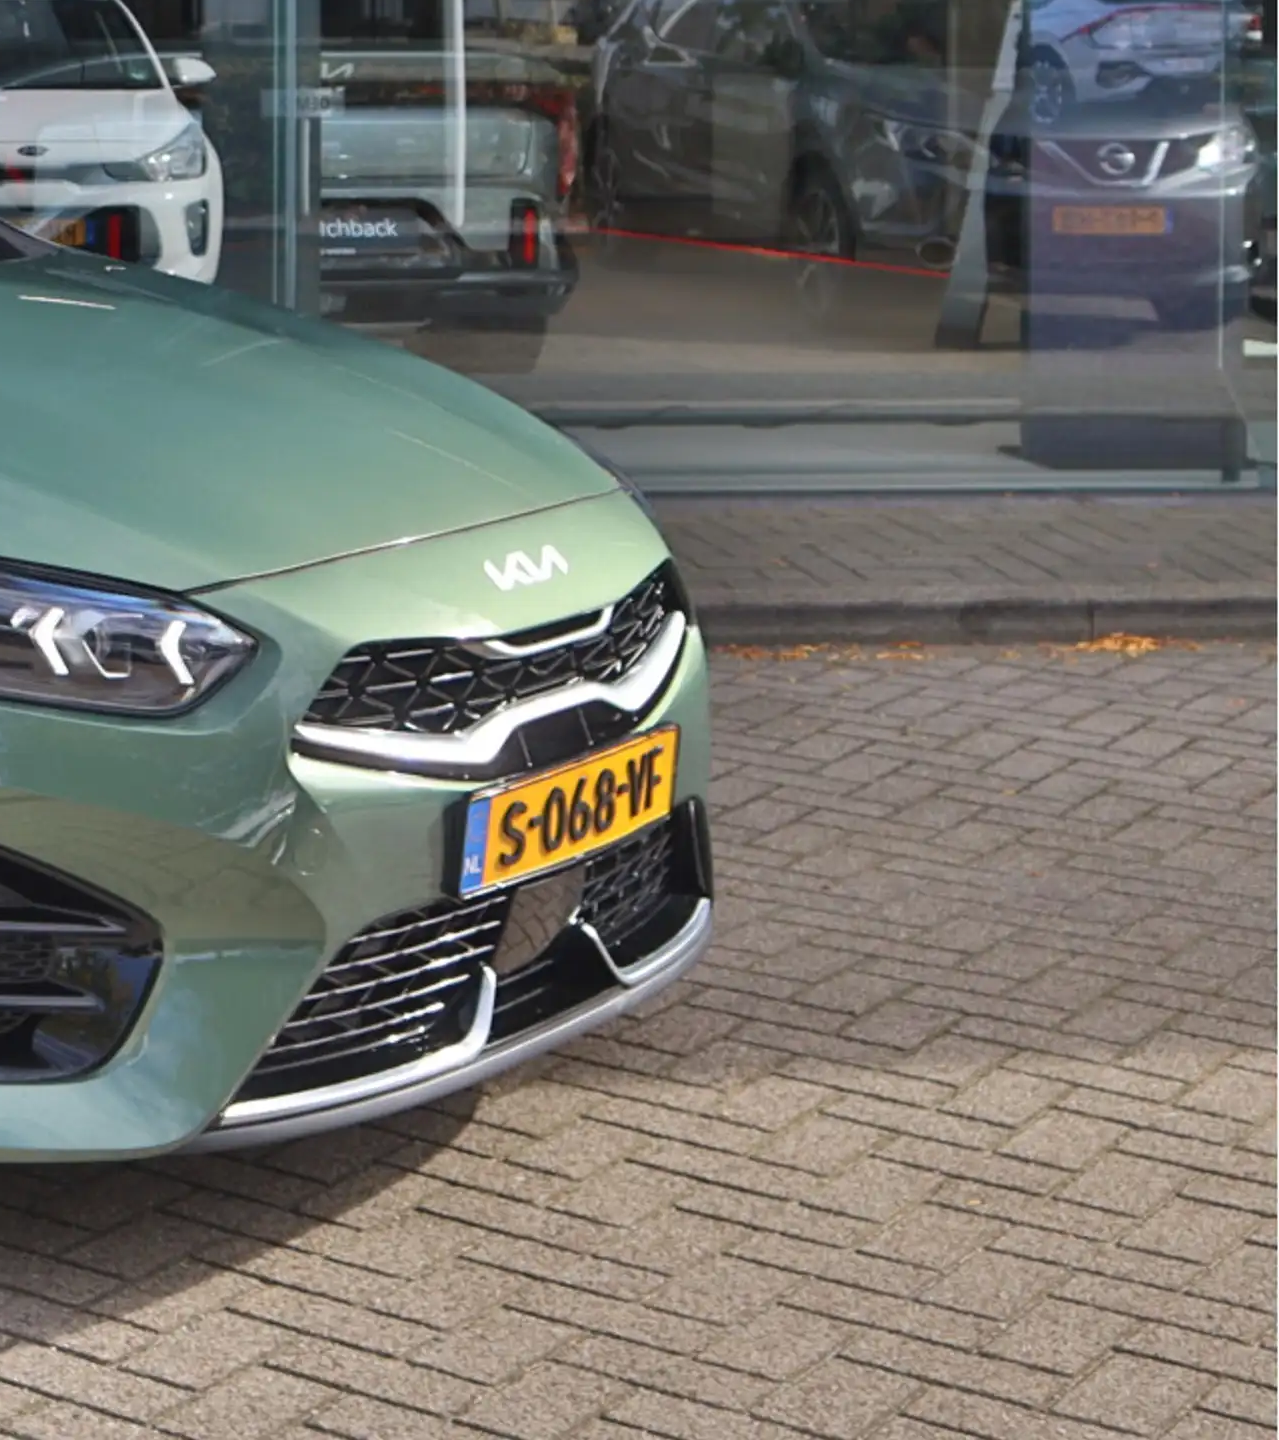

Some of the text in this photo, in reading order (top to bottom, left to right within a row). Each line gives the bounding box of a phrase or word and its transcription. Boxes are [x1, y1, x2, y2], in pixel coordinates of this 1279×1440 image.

[484, 544, 569, 591] KIA
[498, 745, 663, 867] S-068-VF
[463, 854, 482, 877] NL
